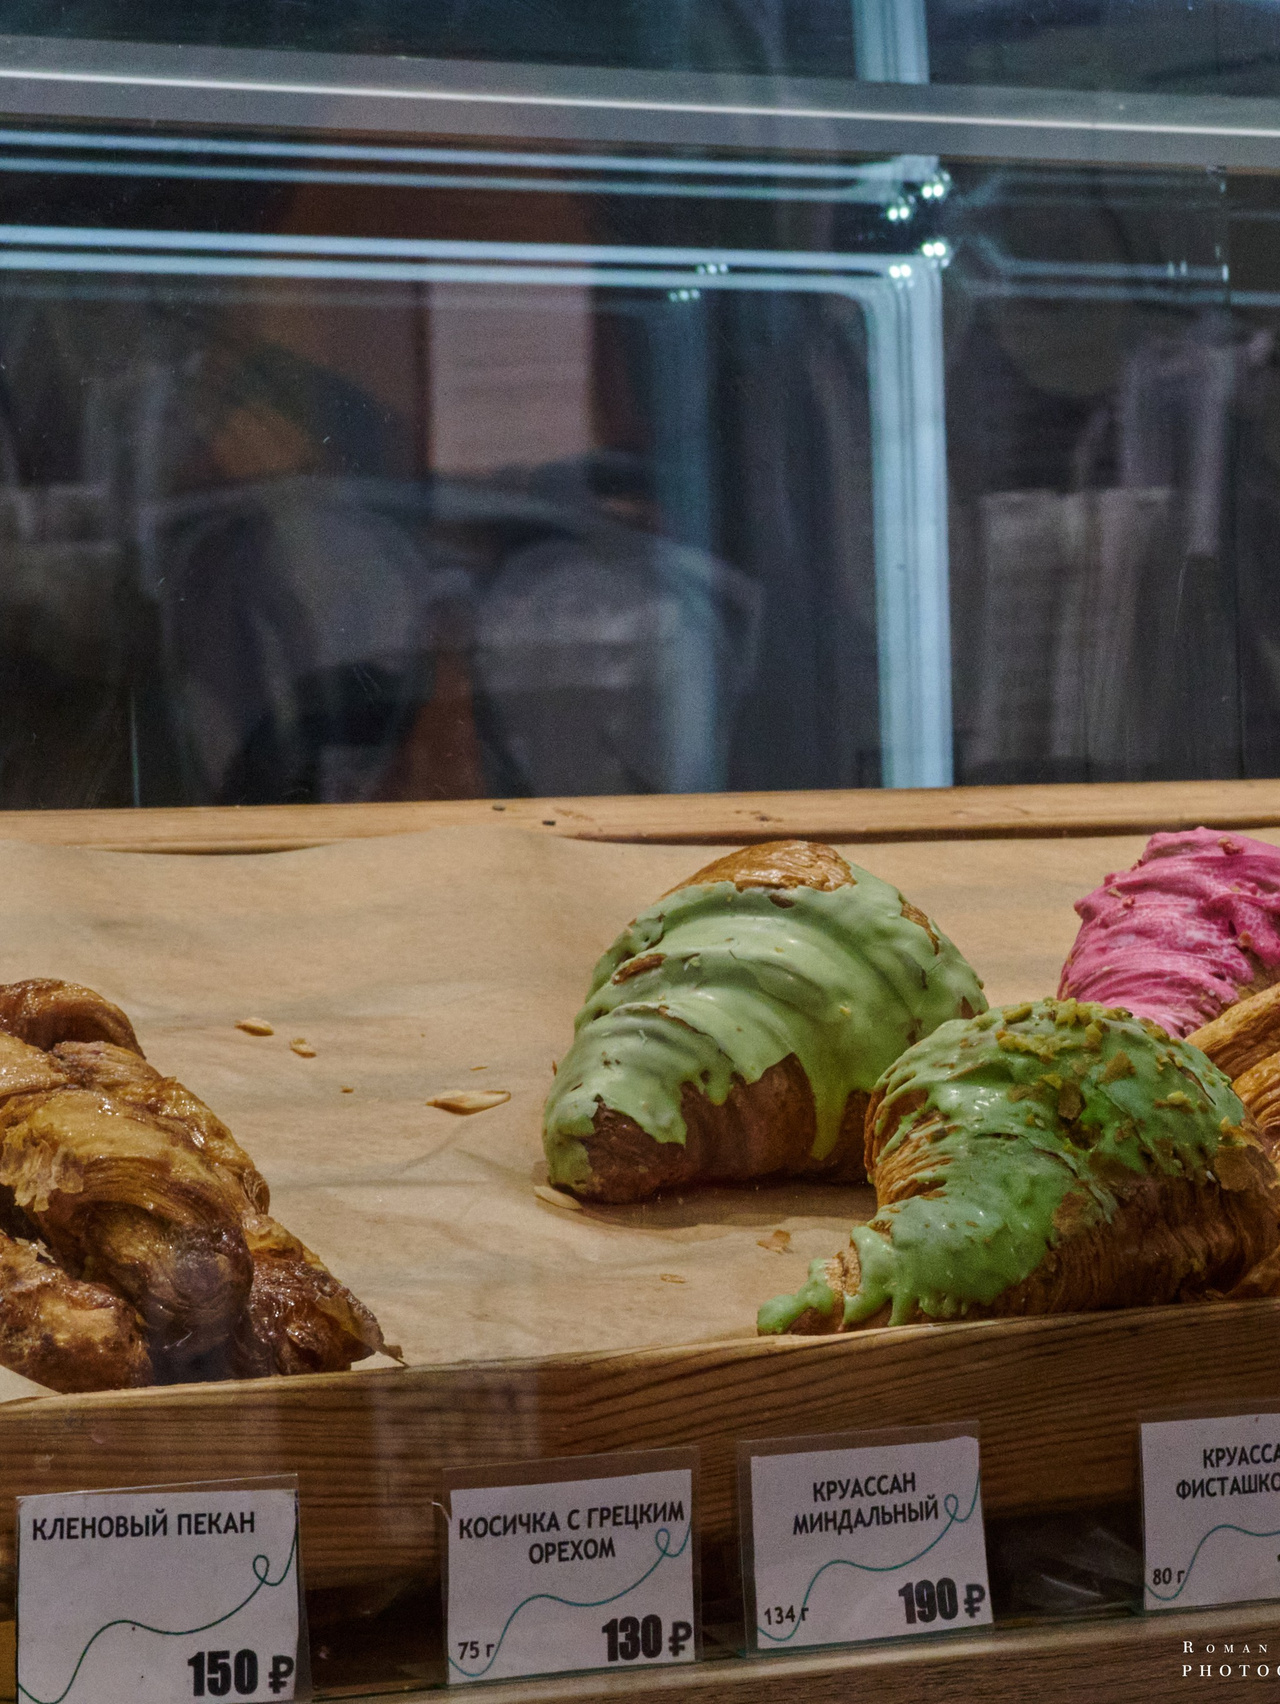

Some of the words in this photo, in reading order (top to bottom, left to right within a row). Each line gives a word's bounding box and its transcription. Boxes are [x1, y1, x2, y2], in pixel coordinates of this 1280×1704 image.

[812, 1471, 916, 1503] КРУАССАН
[32, 1509, 168, 1541] КЛЕНОВЫЙ
[177, 1511, 256, 1536] ПЕКАН
[458, 1508, 562, 1540] КОСИЧКА
[567, 1507, 581, 1529] С
[587, 1500, 685, 1531] ГРЕЦКИМ
[793, 1495, 939, 1535] МИНДАЛЬНЫЙ
[528, 1538, 616, 1564] ОРЕХОМ
[1152, 1567, 1172, 1586] 80
[763, 1606, 795, 1626] 134
[899, 1577, 958, 1625] 190
[457, 1641, 482, 1660] 75
[601, 1614, 663, 1661] 130
[187, 1648, 259, 1697] 150
